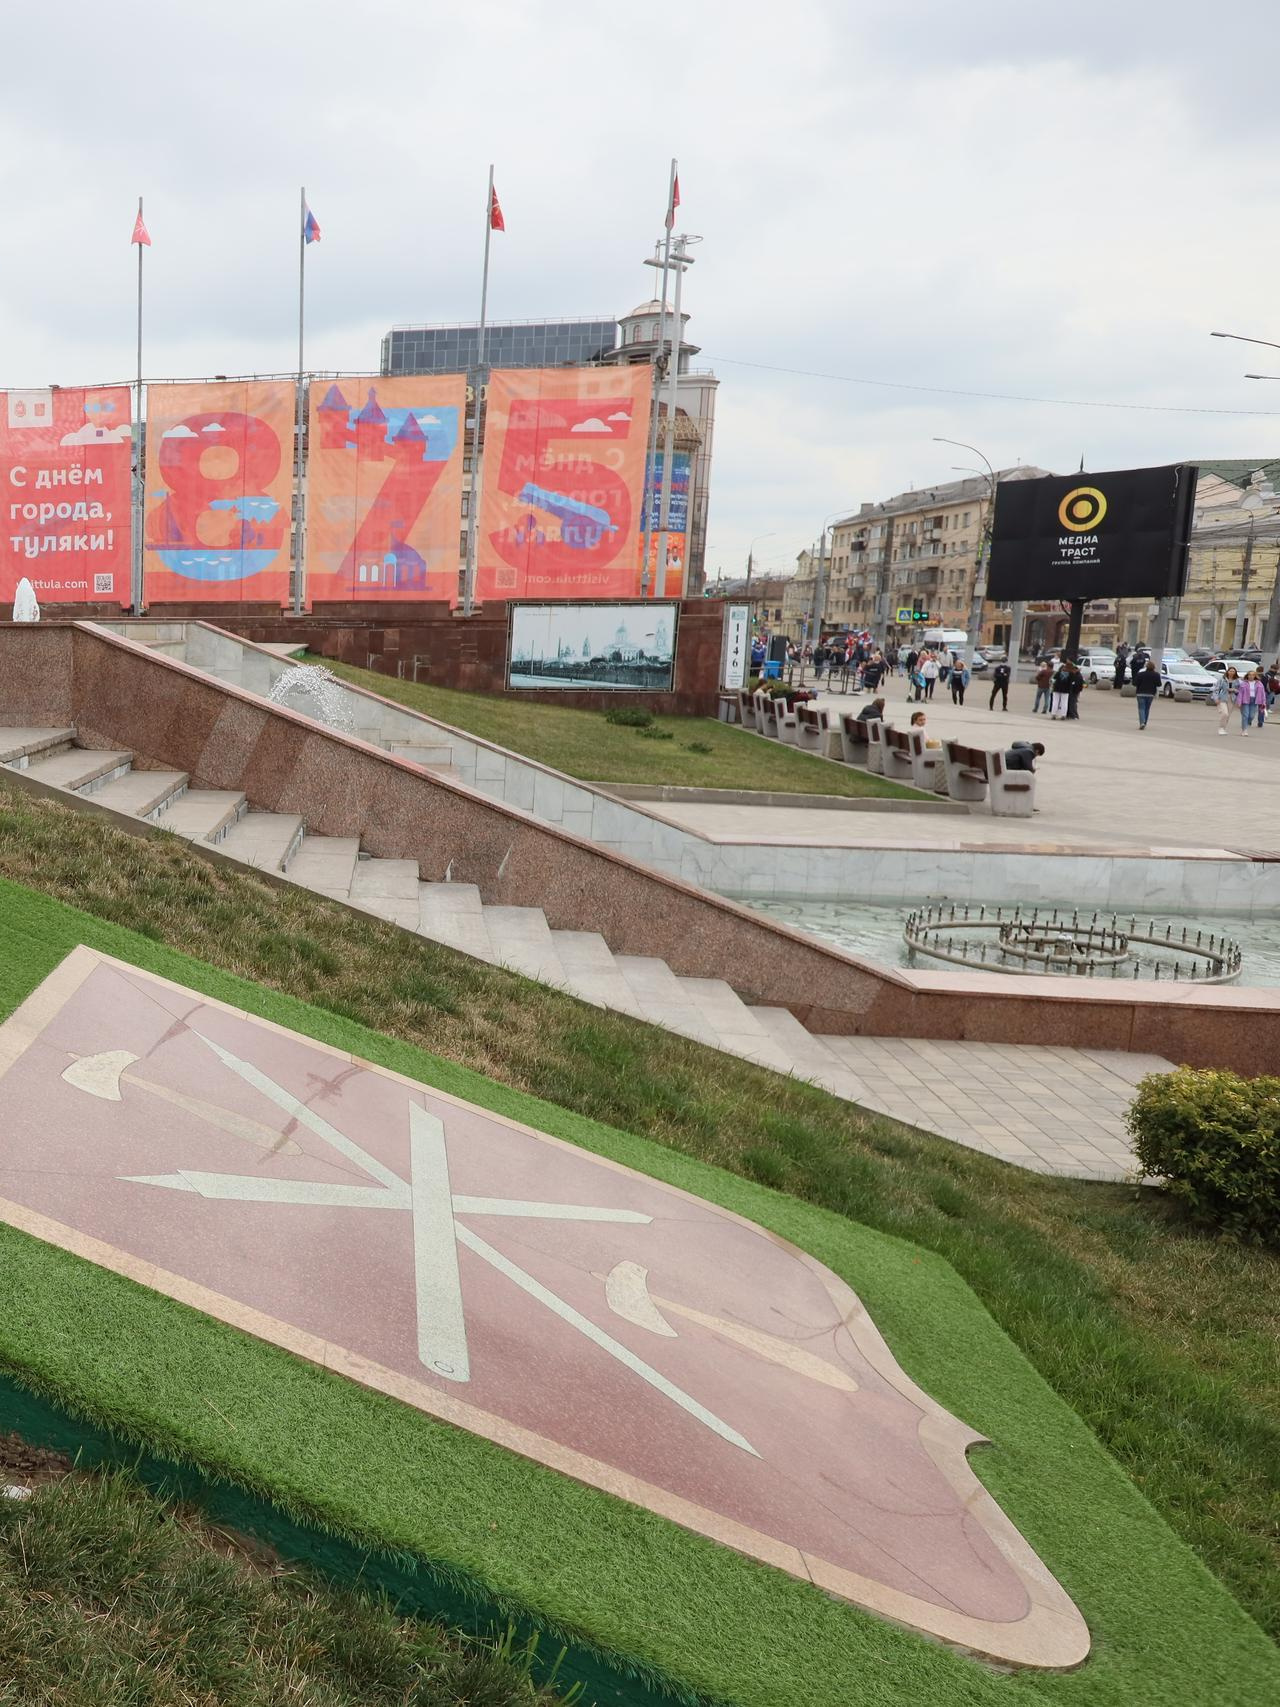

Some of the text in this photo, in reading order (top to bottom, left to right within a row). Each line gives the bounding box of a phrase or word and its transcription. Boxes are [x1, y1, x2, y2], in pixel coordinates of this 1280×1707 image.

[10, 463, 103, 489] С днём
[10, 501, 113, 525] города,
[9, 531, 113, 558] туляки!
[1058, 535, 1099, 546] МЕДИА
[1060, 547, 1096, 558] ТРАСТ
